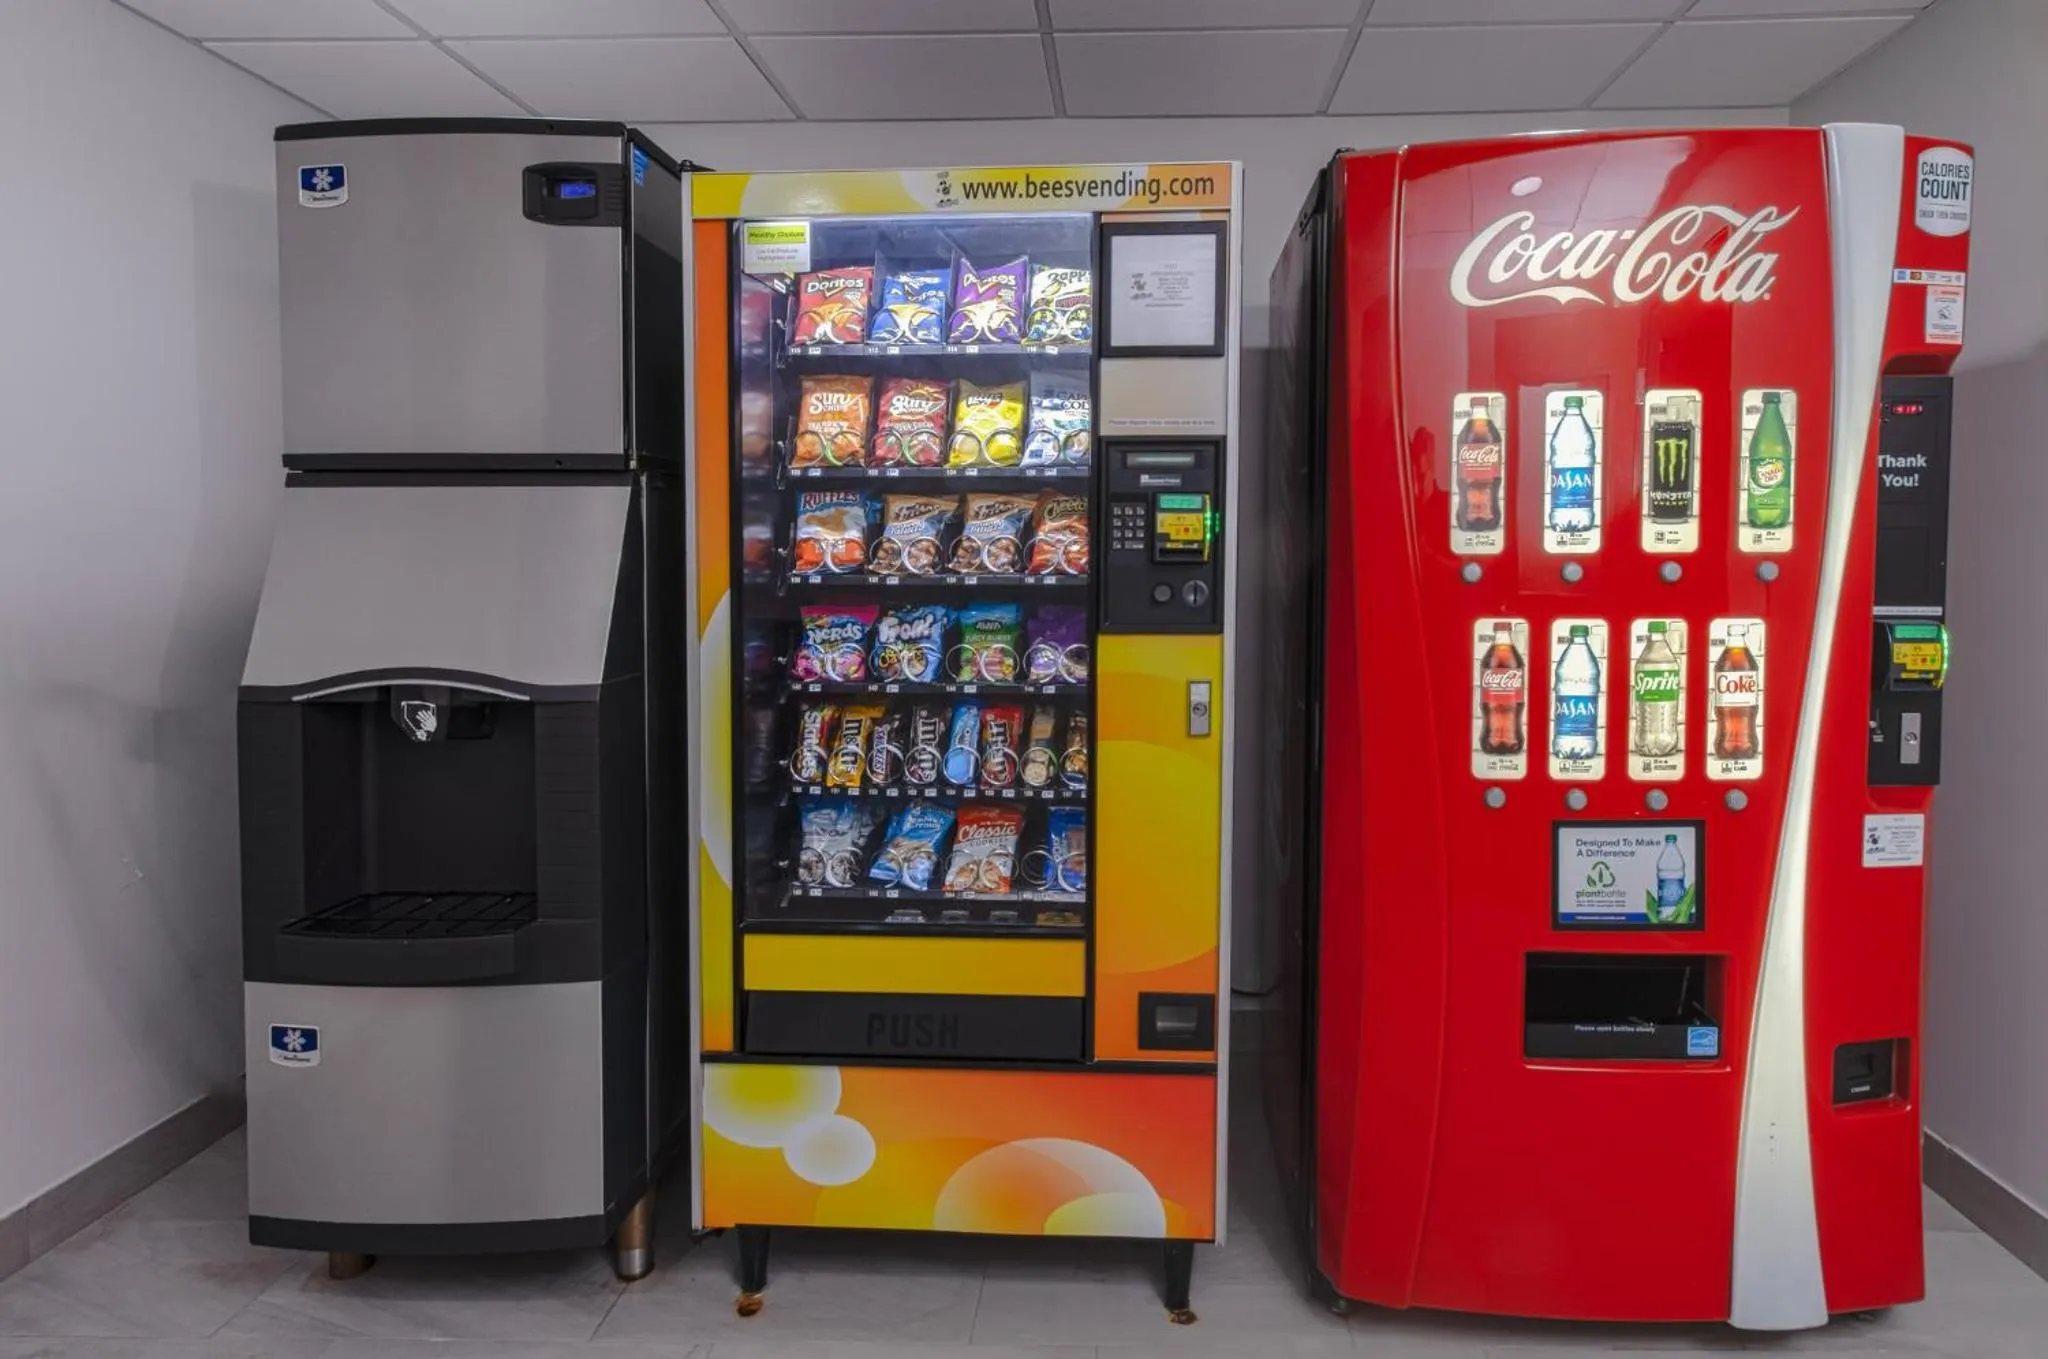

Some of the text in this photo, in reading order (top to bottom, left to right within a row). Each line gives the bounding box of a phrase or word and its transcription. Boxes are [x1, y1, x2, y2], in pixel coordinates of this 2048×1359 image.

[1921, 161, 1970, 179] CALORIES
[962, 171, 1215, 204] www.beesvending.com
[1920, 178, 1970, 201] COUNT
[1450, 205, 1801, 307] Coca-Cola
[807, 278, 864, 293] Doritos
[809, 391, 852, 415] Sun
[1459, 445, 1499, 464] Coca-Cola
[1877, 453, 1927, 468] Thank
[1551, 470, 1592, 491] DASAN
[1881, 473, 1919, 488] You!
[801, 490, 861, 510] RUFFLES
[1650, 490, 1693, 502] MONSTER
[1043, 498, 1089, 519] Cheeto
[1482, 670, 1522, 688] Coca-Cola
[1635, 671, 1680, 694] Sprite
[1717, 674, 1757, 694] Coke
[1556, 699, 1596, 719] DASAN
[960, 822, 1017, 841] Classic
[1575, 838, 1661, 849] Designed To Make
[1586, 849, 1635, 858] Difference
[1576, 888, 1627, 899] plantbottle
[866, 1012, 960, 1050] PUSH
